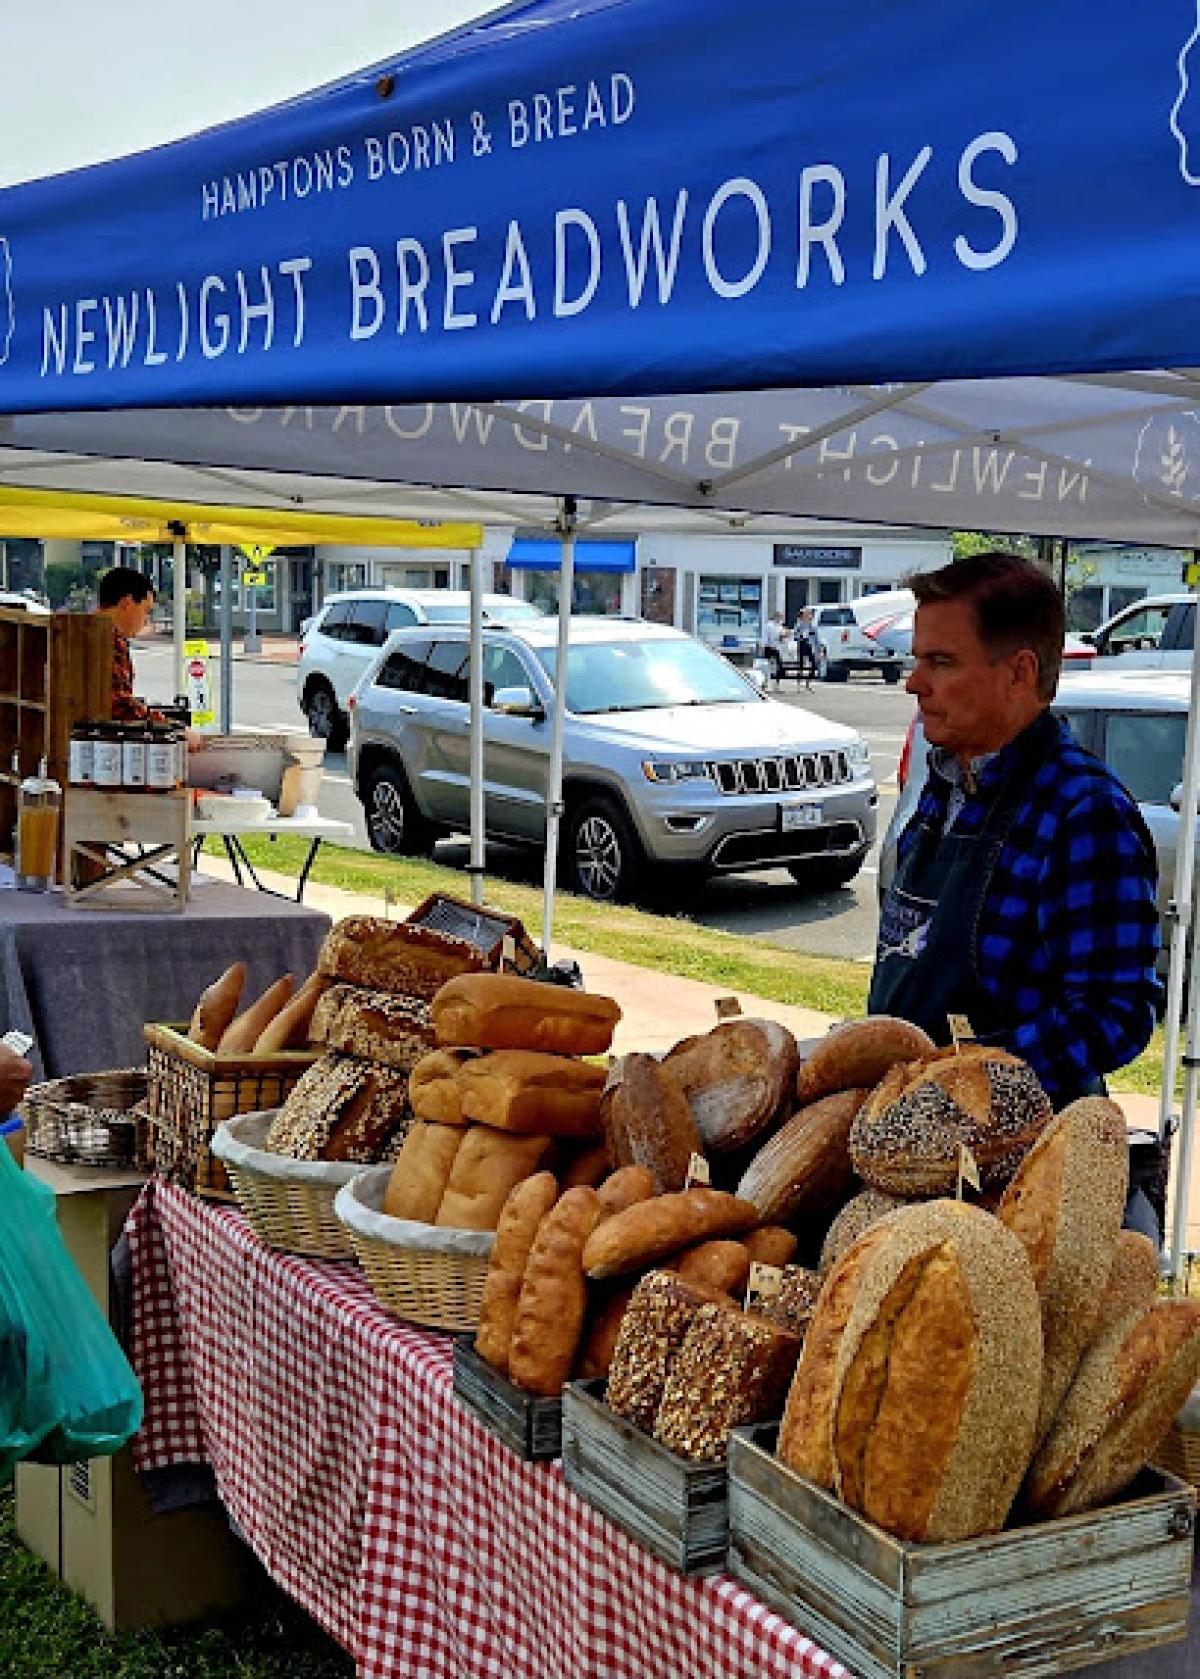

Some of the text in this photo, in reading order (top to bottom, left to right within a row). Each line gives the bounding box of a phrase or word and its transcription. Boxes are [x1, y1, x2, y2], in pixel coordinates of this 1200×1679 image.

[201, 73, 636, 221] HAMPTONS BORN & BREAD
[40, 131, 1019, 378] NEWLIGHT BREADWORKS
